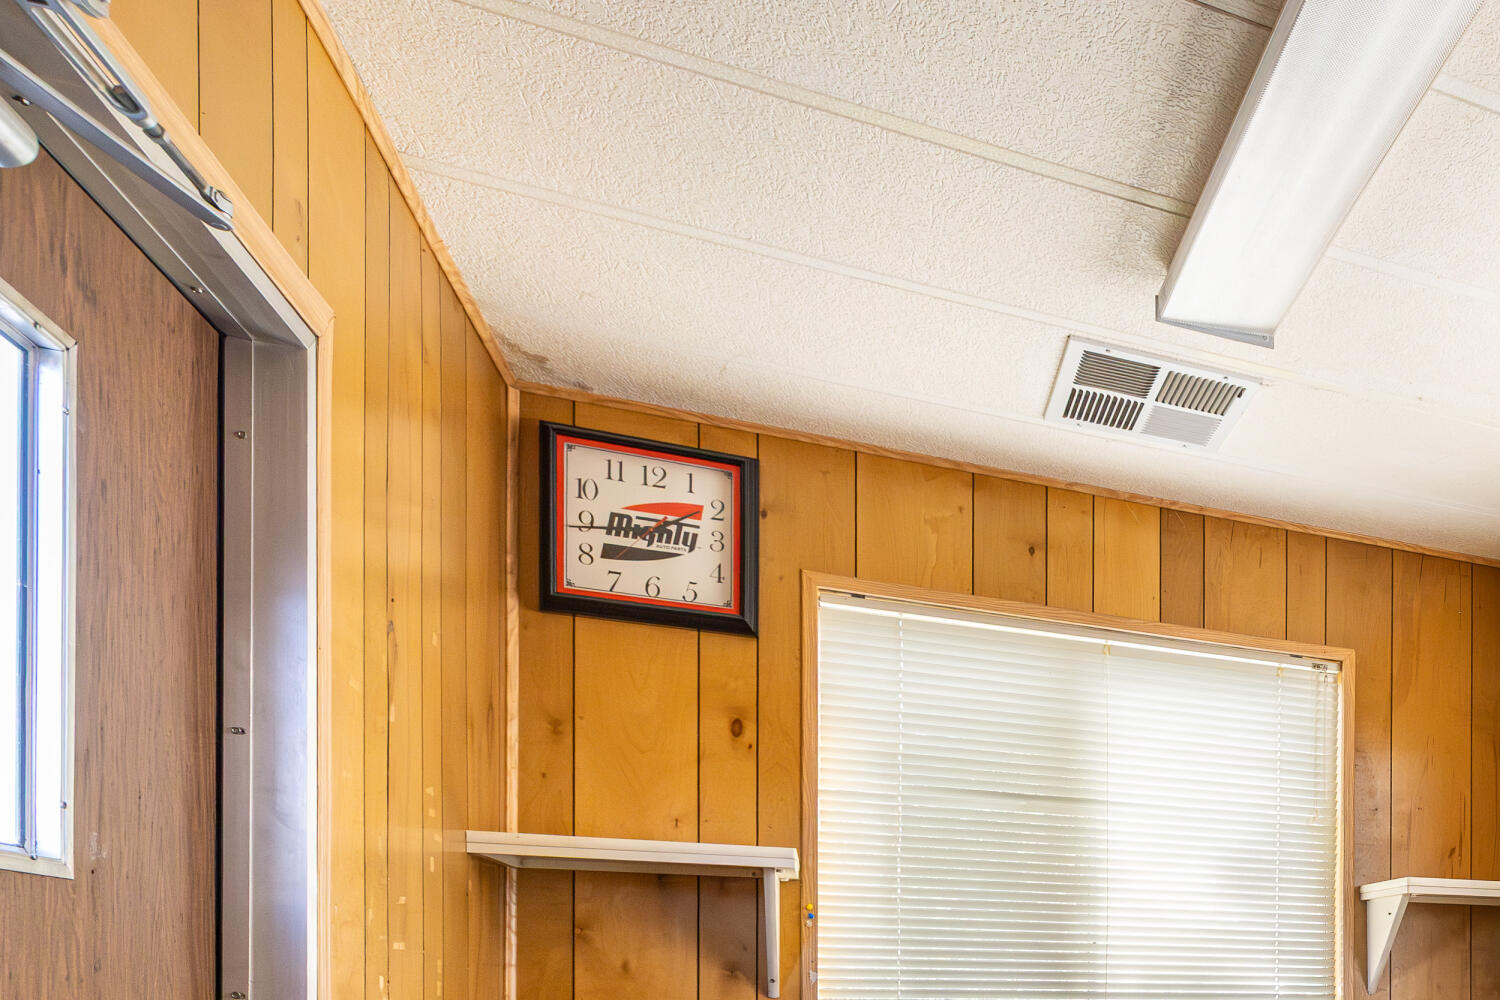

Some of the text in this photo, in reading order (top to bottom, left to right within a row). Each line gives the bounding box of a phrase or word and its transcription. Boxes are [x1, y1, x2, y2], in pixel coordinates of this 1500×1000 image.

[605, 459, 696, 494] 11 12 1
[575, 478, 599, 501] 10
[578, 510, 595, 532] 9
[710, 500, 725, 521] 2
[710, 531, 725, 552] 3
[578, 543, 595, 565] 8
[607, 570, 622, 593] 7
[709, 563, 725, 584] 4
[645, 576, 661, 597] 6
[682, 581, 698, 603] 5
